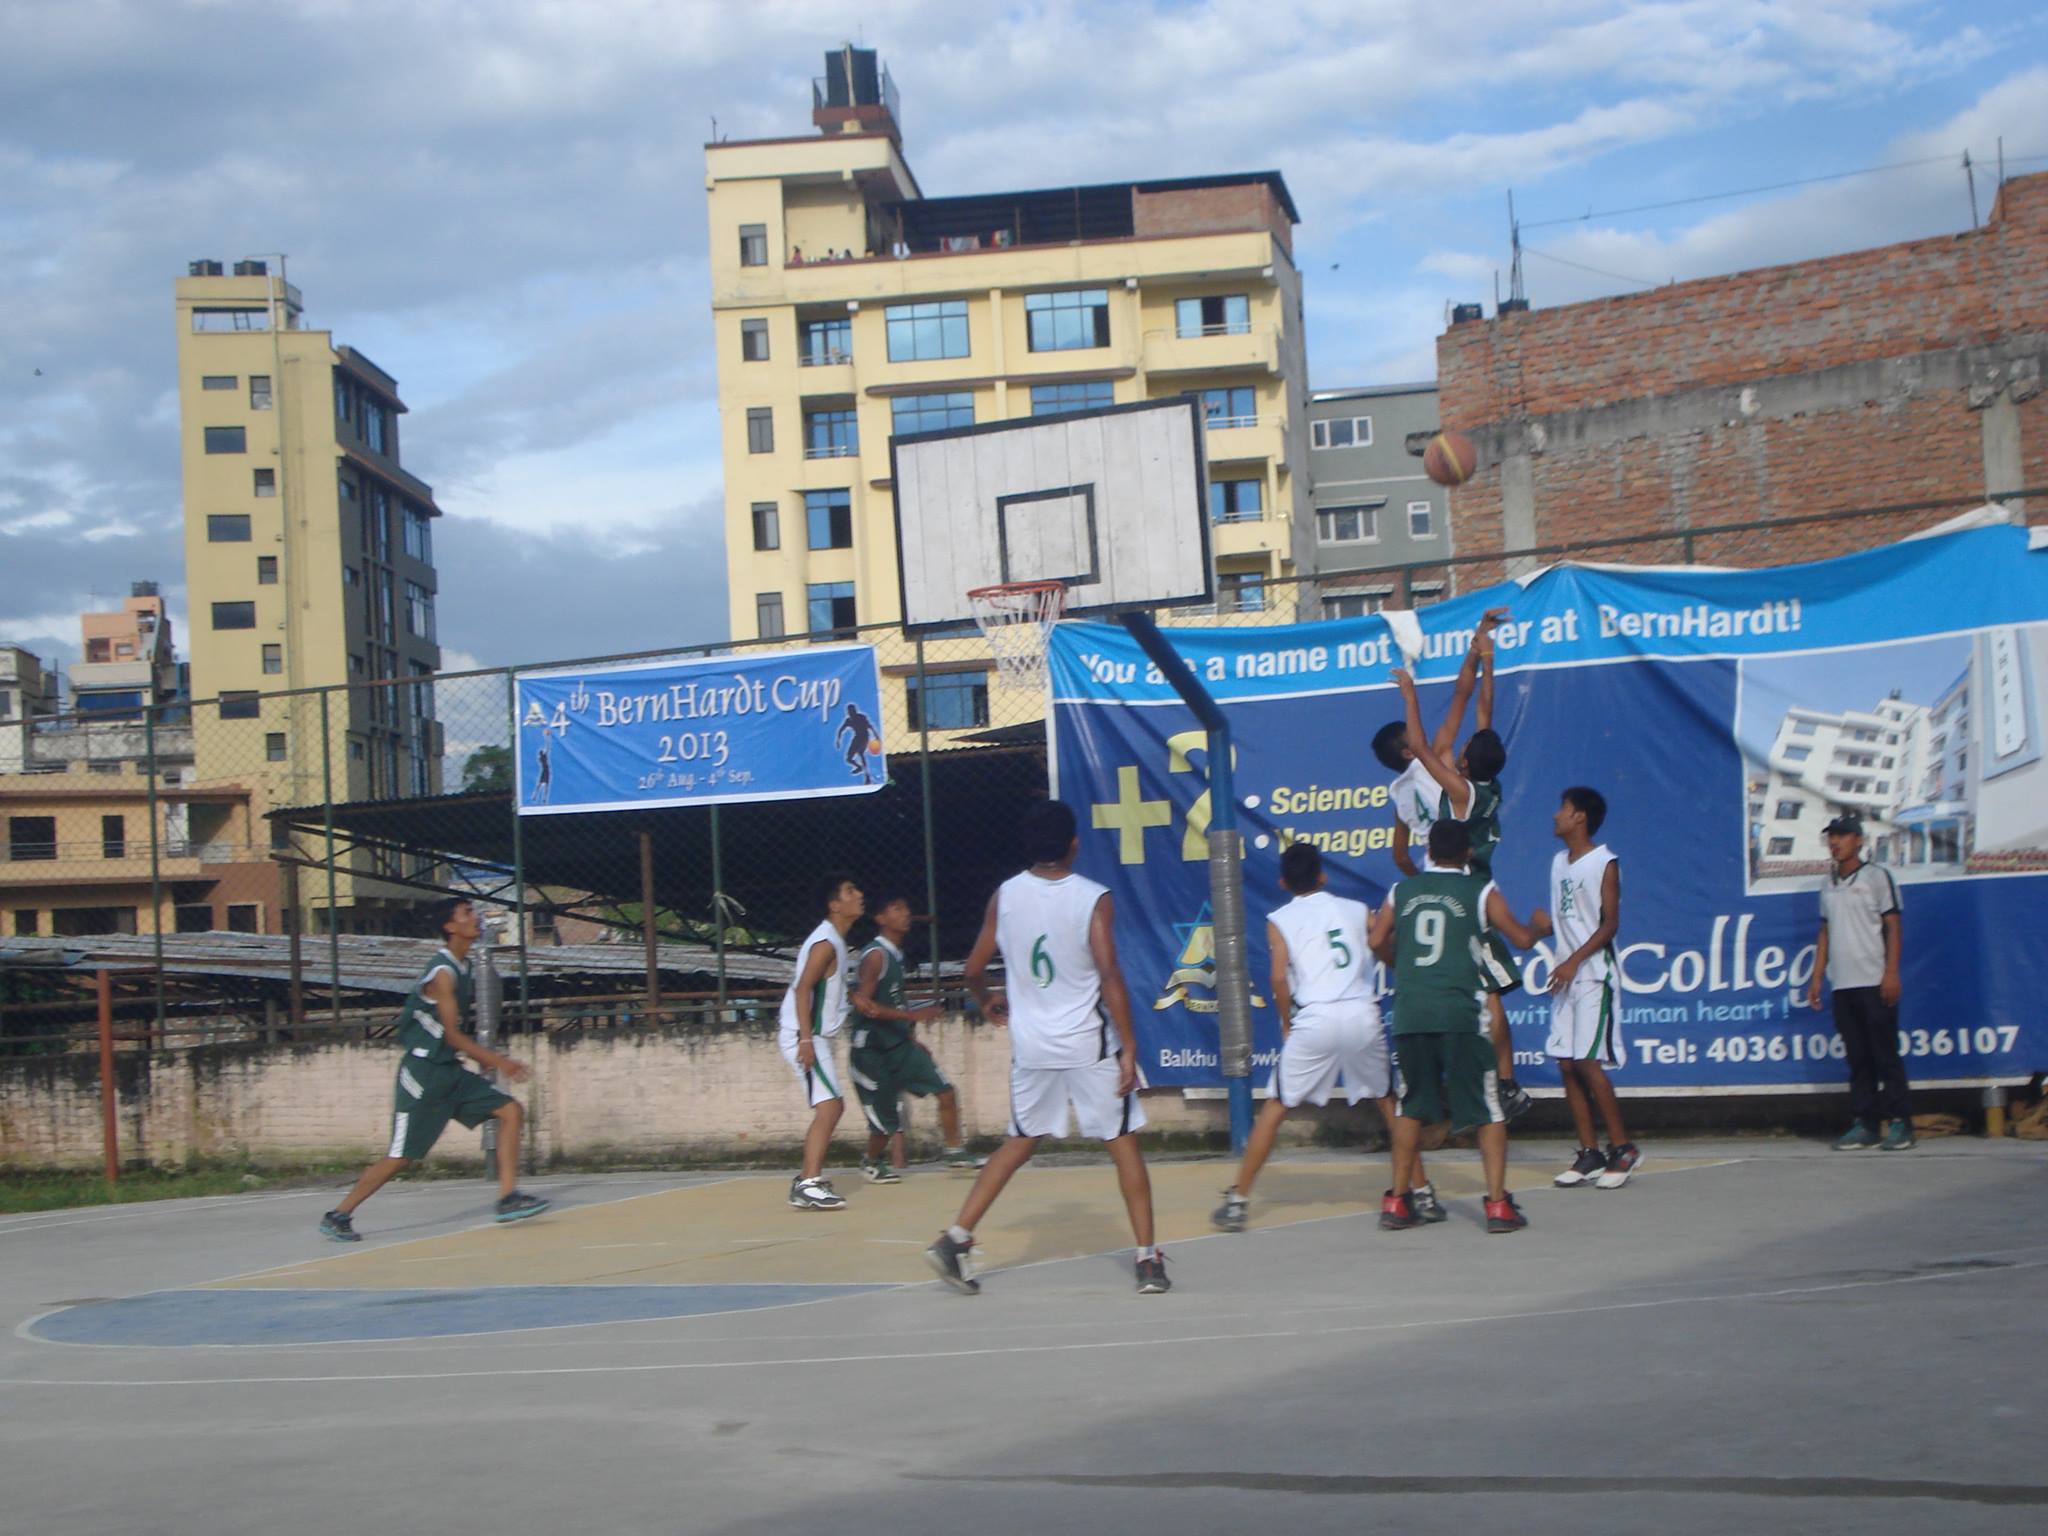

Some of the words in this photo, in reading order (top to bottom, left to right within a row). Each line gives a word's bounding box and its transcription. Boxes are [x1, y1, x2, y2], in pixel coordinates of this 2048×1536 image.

[1079, 653, 1136, 684] You
[1205, 655, 1226, 681] a
[1236, 645, 1328, 678] name
[1337, 634, 1392, 667] not
[1423, 620, 1535, 659] umer
[1541, 609, 1578, 644] at
[1600, 599, 1802, 639] BernHardt!
[550, 680, 590, 737] 4th
[597, 674, 767, 728] BernHardt
[773, 675, 841, 722] Cup
[658, 731, 729, 767] 2013
[1270, 785, 1388, 815] Science
[1414, 788, 1437, 825] 4
[1327, 928, 1350, 969] 5
[1415, 909, 1446, 967] 9
[1030, 933, 1055, 989] 6
[1620, 914, 1820, 1008] Colleg
[1507, 1004, 1549, 1025] wit
[1620, 1007, 1688, 1024] uman
[1699, 999, 1774, 1023] heart
[1160, 1048, 1217, 1068] Balkhu
[1634, 1038, 1697, 1064] Tel:
[1897, 1025, 2020, 1057] 036107
